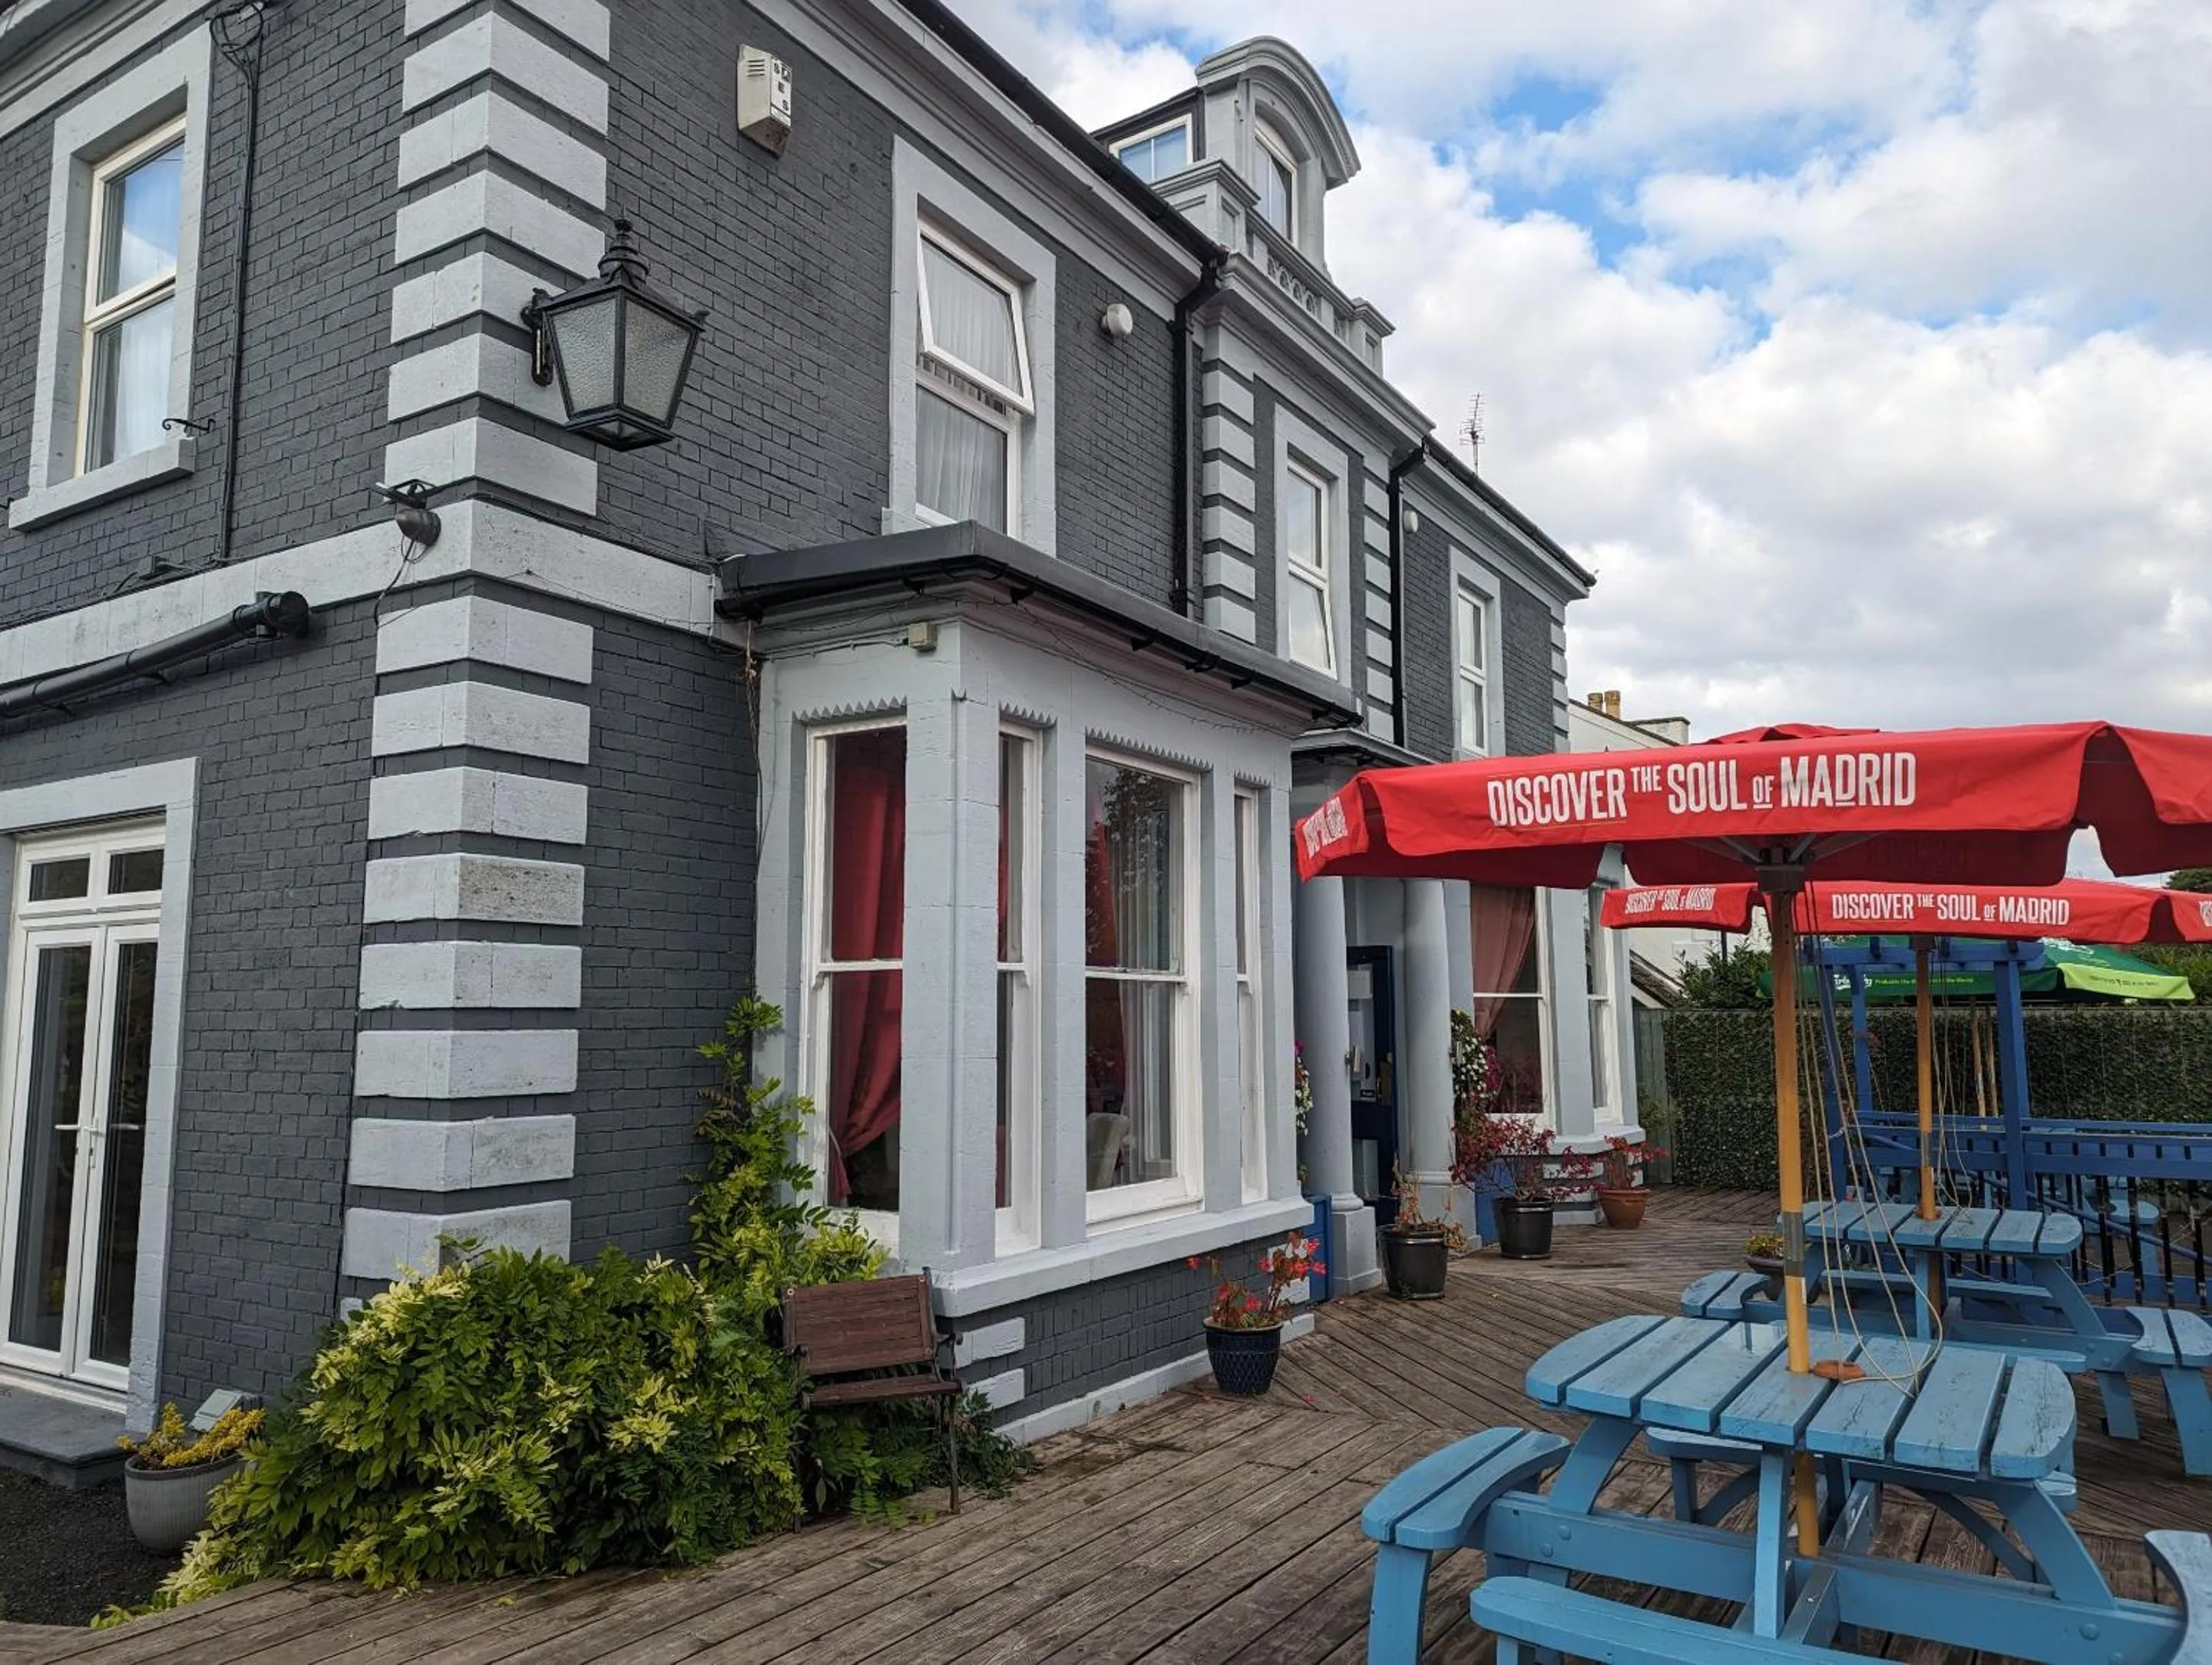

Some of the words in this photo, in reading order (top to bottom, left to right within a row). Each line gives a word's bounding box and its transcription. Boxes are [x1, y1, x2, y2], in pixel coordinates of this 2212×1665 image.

[1487, 767, 1628, 827] DISCOVER
[1630, 765, 1663, 793] THE
[1667, 759, 1748, 814] SOUL
[1752, 775, 1774, 809] OF
[1781, 752, 1916, 808] MADRID
[1831, 892, 1915, 921] DISCOVER
[1916, 893, 1936, 908] THE
[1937, 894, 1982, 921] SOUL
[1983, 904, 1996, 922] OF
[1999, 895, 2070, 926] MADRID
